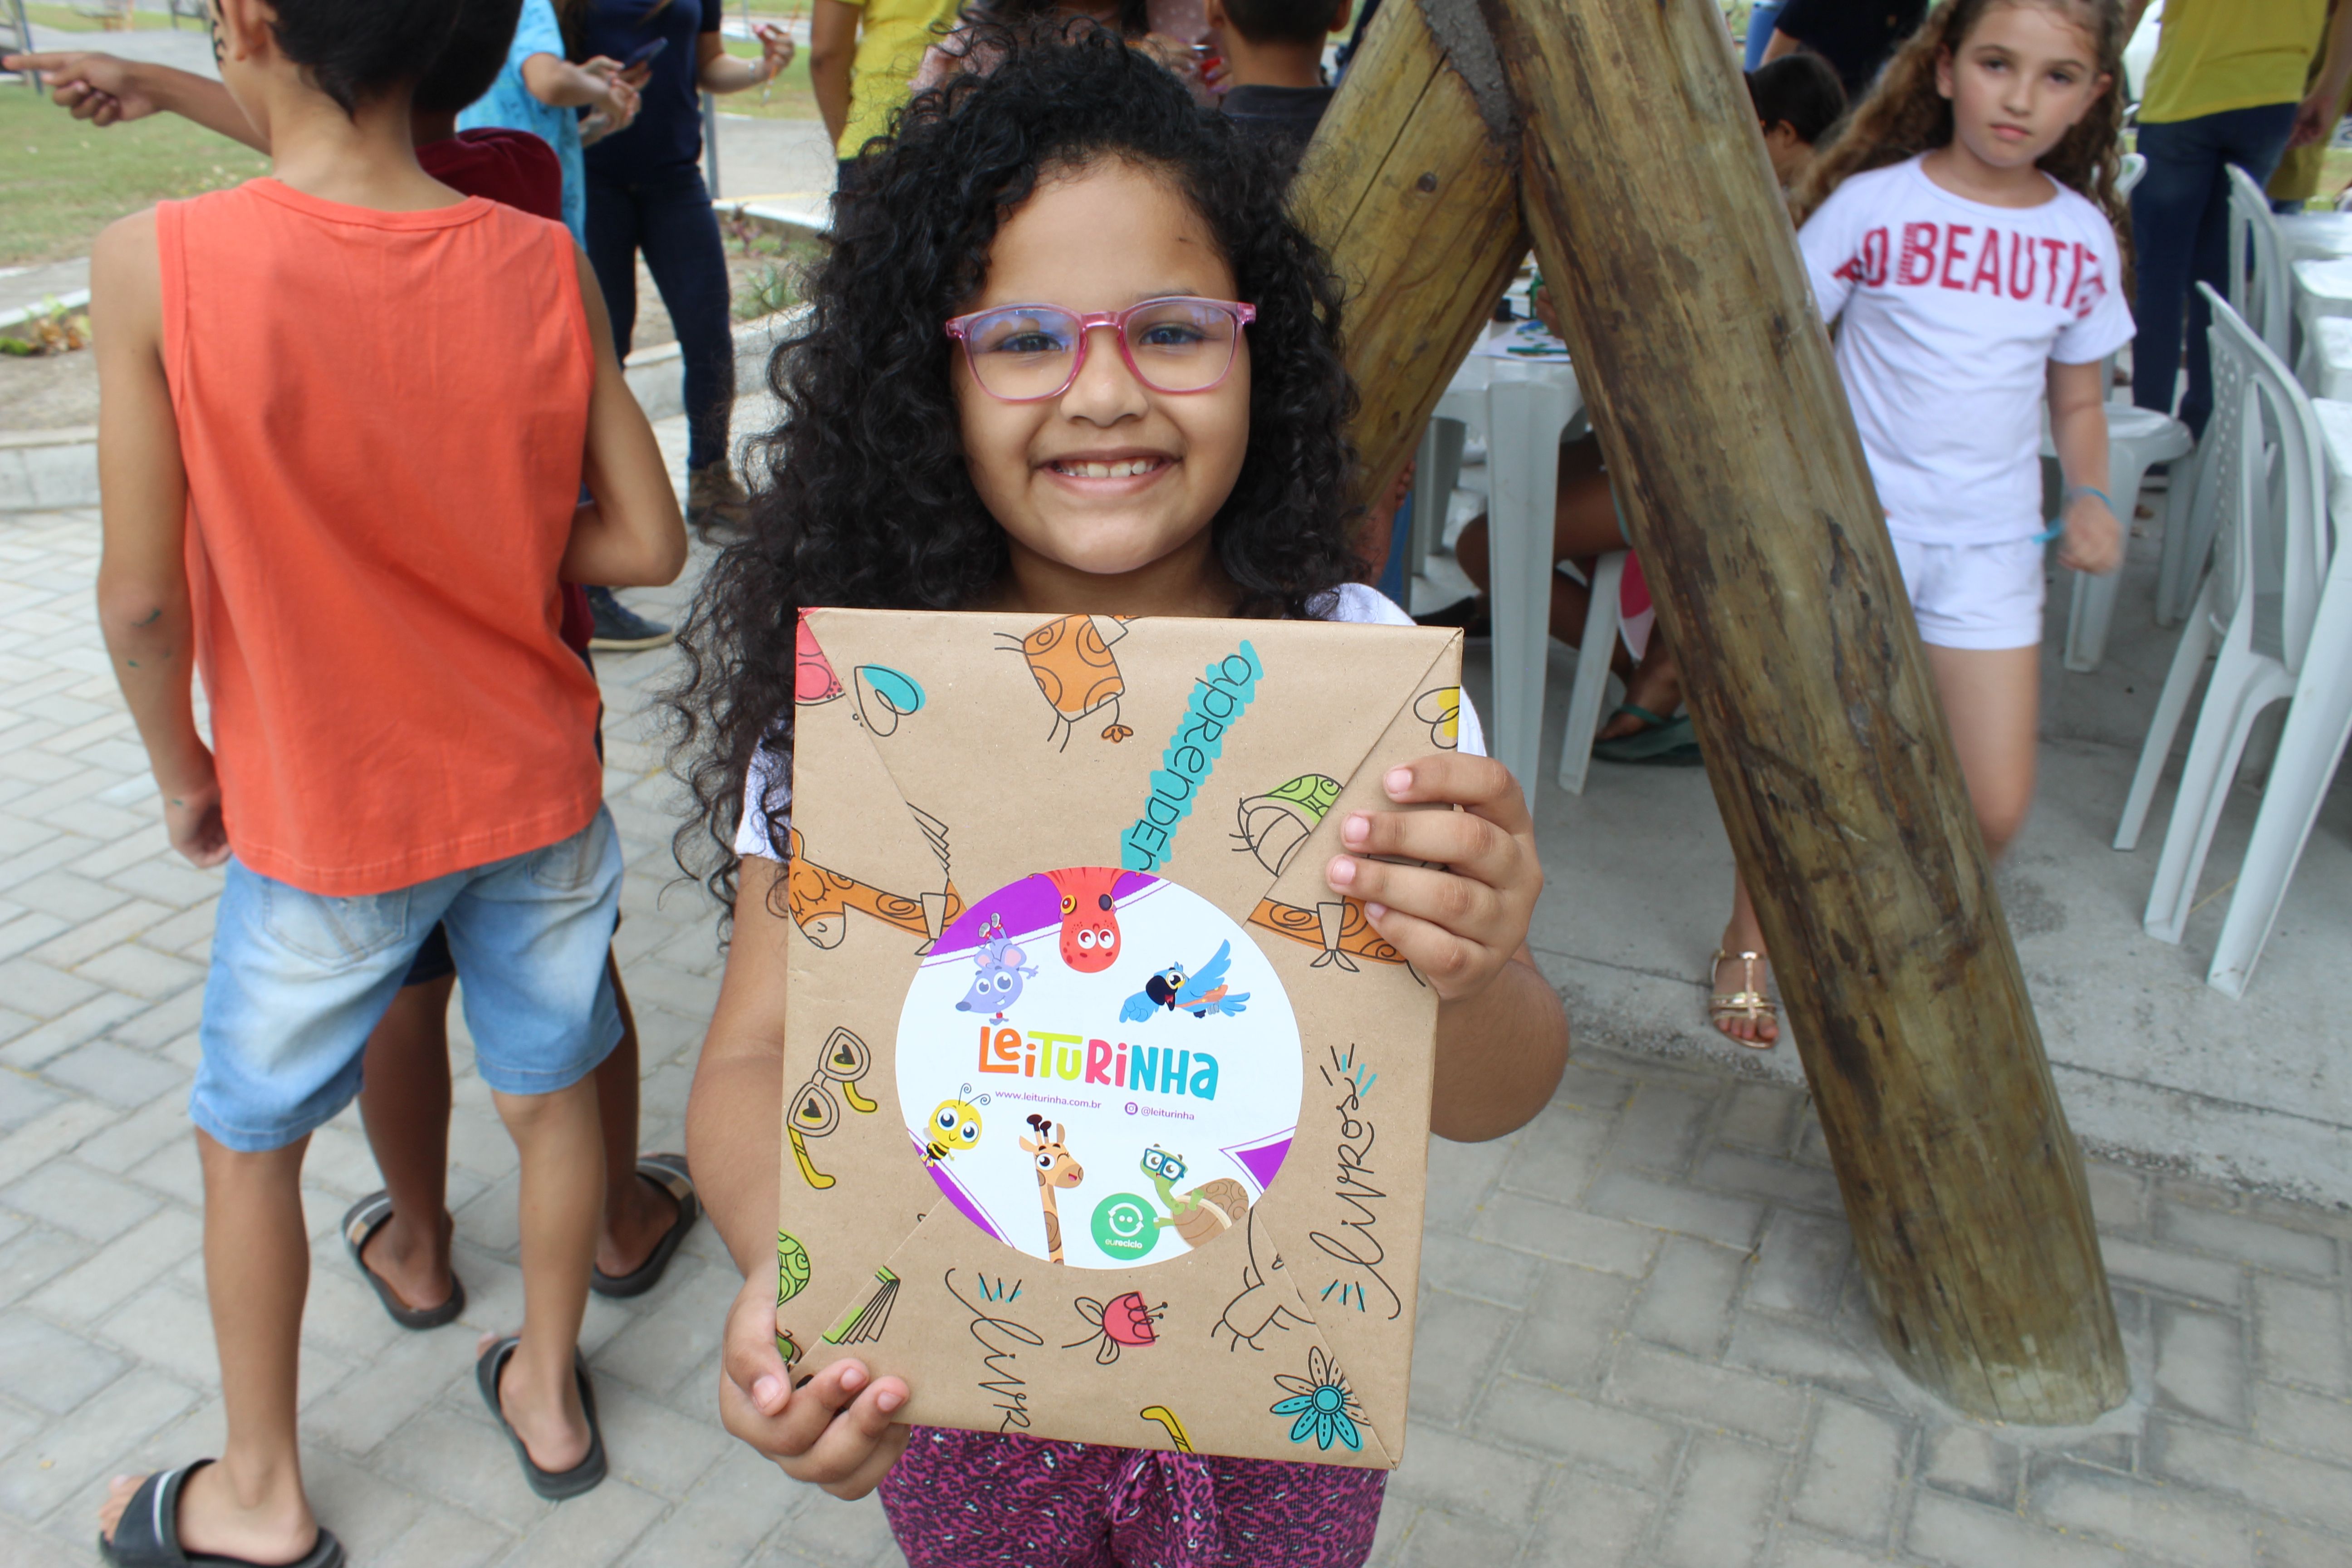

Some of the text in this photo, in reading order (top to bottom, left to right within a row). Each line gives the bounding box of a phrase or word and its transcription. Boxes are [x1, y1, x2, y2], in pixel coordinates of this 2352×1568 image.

[995, 1089, 1102, 1109] www.leiturinha.com.br
[1141, 1106, 1195, 1121] @leiturinha
[1105, 1238, 1143, 1249] eureciclo
